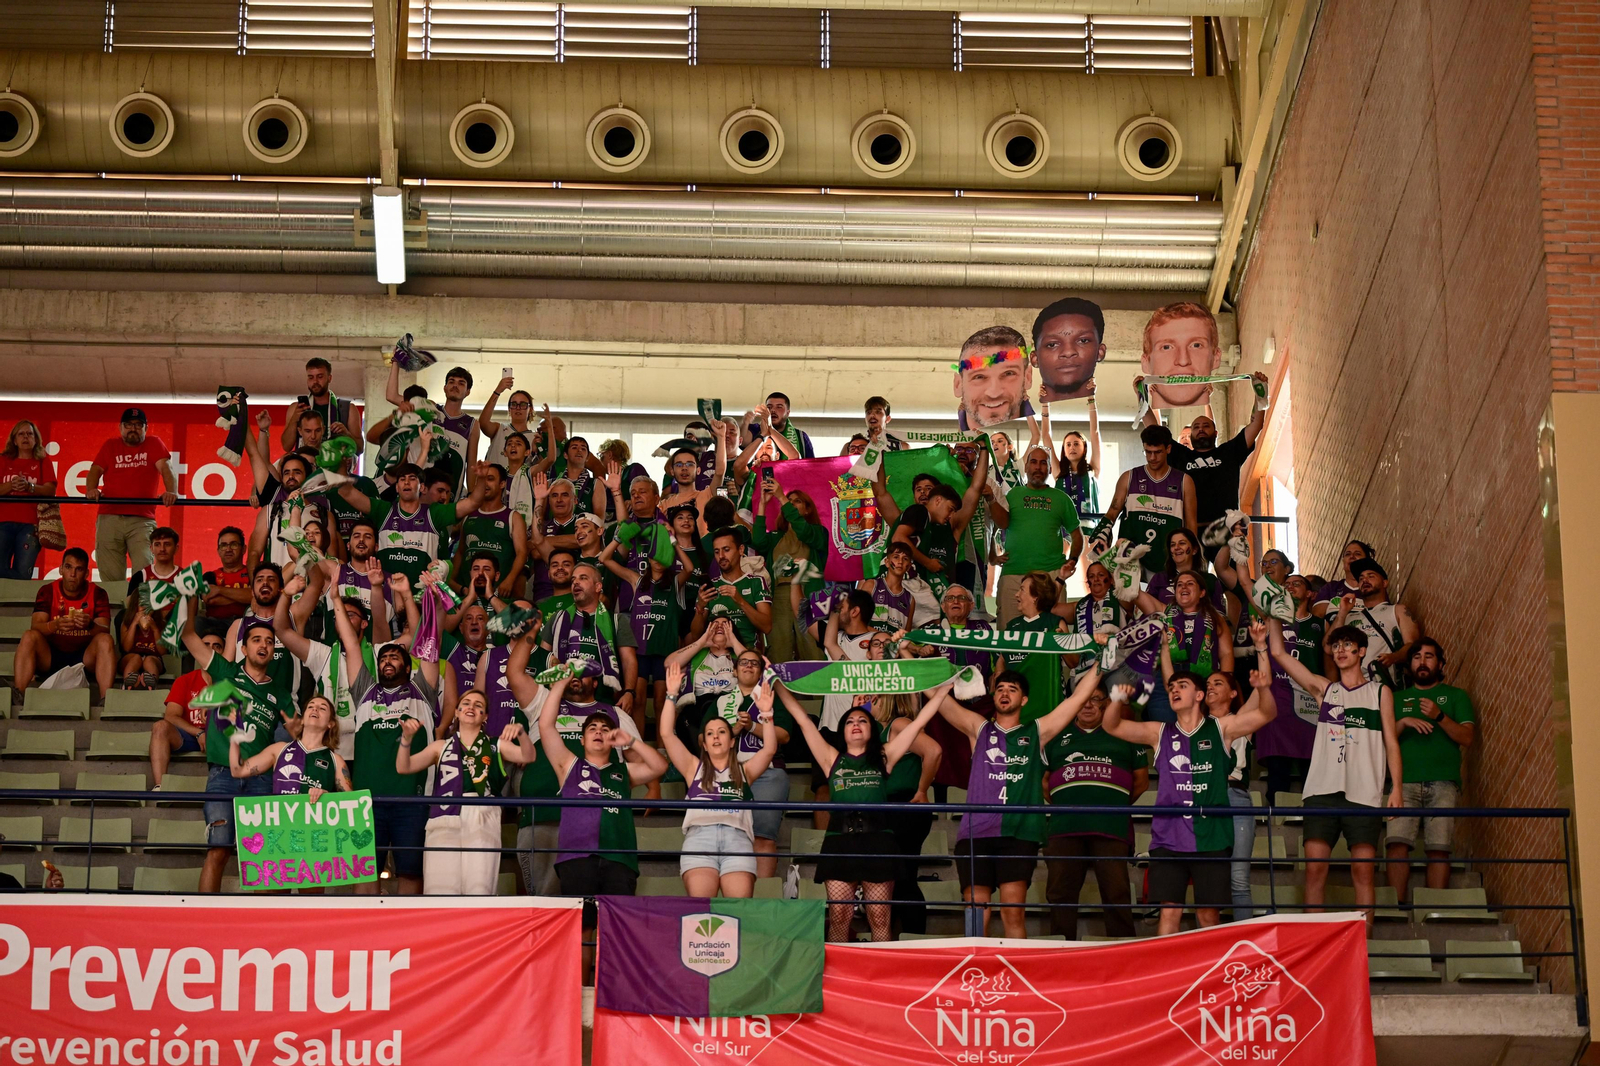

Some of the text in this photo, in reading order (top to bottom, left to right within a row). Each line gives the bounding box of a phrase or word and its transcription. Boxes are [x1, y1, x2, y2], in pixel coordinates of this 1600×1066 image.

[115, 452, 148, 464] UCAM
[1152, 502, 1173, 512] Unicaja
[1138, 513, 1167, 525] málaga
[1145, 528, 1157, 543] 9
[477, 540, 502, 550] Unicaja
[389, 552, 418, 562] málaga
[636, 611, 666, 621] málaga
[642, 624, 655, 640] 17
[842, 662, 902, 678] UNICAJA
[831, 676, 915, 692] BALONCESTO
[1004, 755, 1029, 765] Unicaja
[1083, 755, 1112, 763] Unicaja
[1078, 765, 1112, 774] MÁLAGA
[1189, 761, 1213, 772] Unicaja
[299, 774, 322, 789] Unicaja
[988, 771, 1023, 783] málaga
[598, 787, 622, 800] Unicaja
[717, 786, 744, 797] Unicaja
[998, 785, 1008, 804] 4
[238, 796, 373, 828] WHY NOT?
[267, 828, 350, 855] KEEP
[241, 854, 375, 887] DREAMING
[688, 941, 730, 949] Fundación
[694, 950, 725, 958] Unicaja
[936, 996, 953, 1007] La
[1199, 990, 1217, 1004] La
[935, 1008, 1035, 1047] Niña
[1198, 1005, 1297, 1044] Niña
[233, 1039, 260, 1066] y
[272, 1029, 402, 1066] Salud
[692, 1040, 751, 1056] del Sur
[1221, 1045, 1278, 1060] del Sur
[956, 1050, 1015, 1064] del Sur
